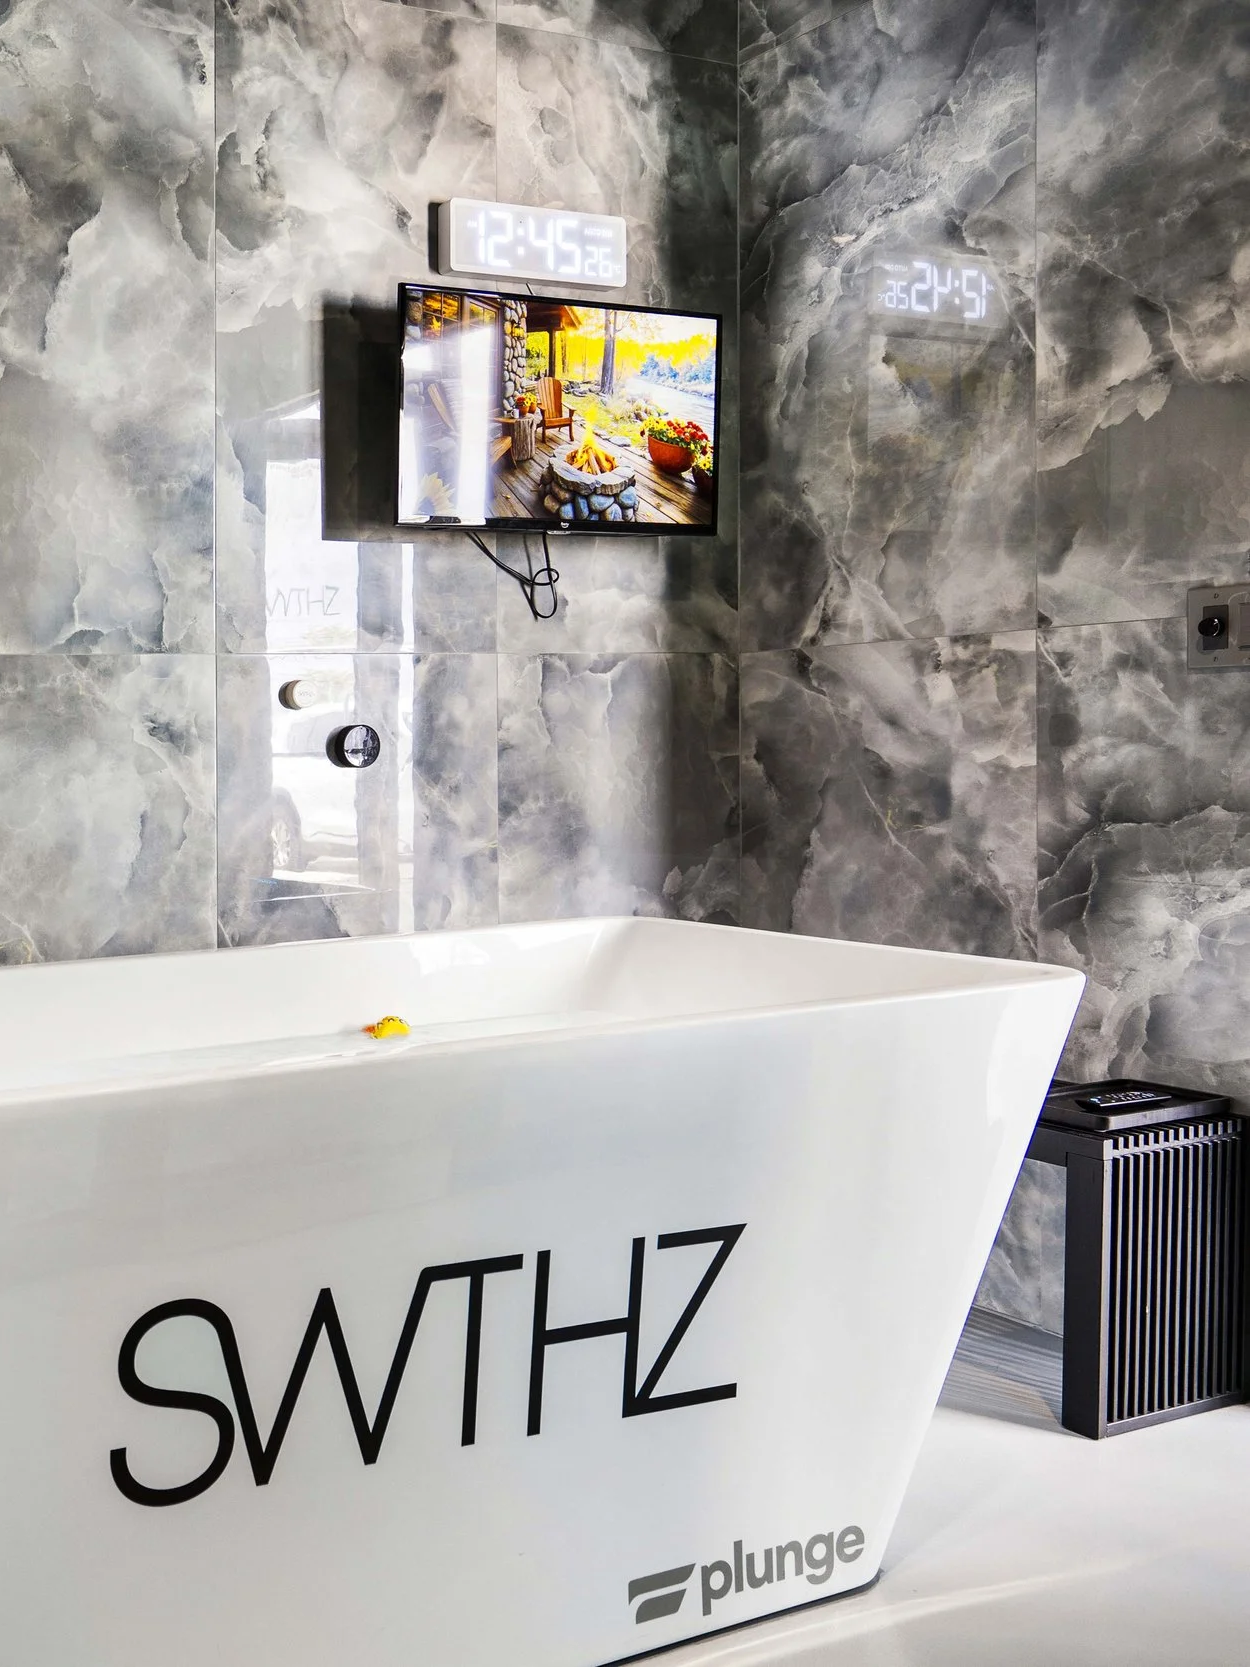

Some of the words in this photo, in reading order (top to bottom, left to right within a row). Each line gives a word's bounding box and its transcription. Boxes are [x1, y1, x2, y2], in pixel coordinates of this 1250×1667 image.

[478, 210, 581, 274] 12:45
[110, 1223, 747, 1507] SWTHZ
[700, 1525, 865, 1617] plunge
